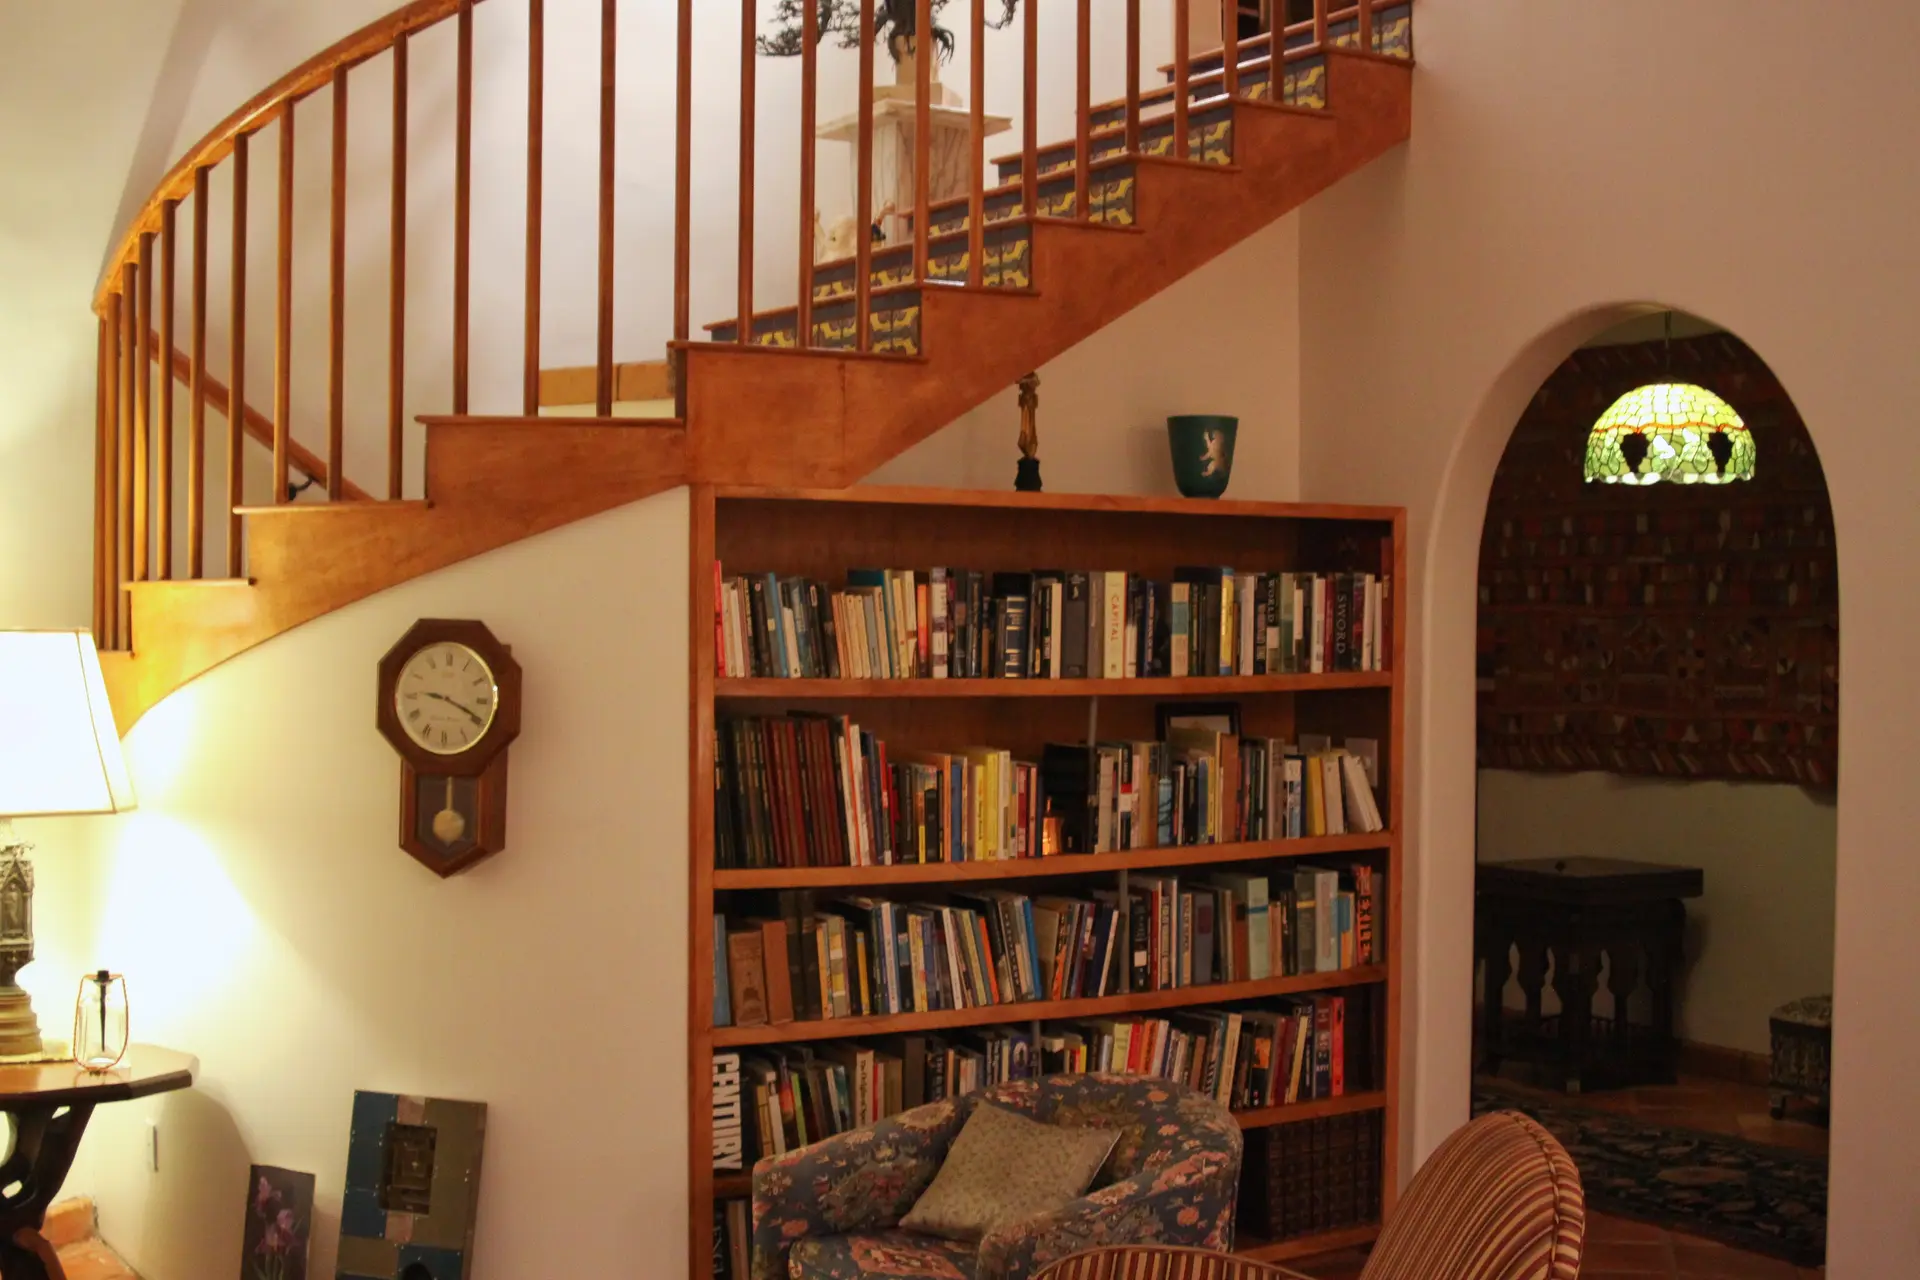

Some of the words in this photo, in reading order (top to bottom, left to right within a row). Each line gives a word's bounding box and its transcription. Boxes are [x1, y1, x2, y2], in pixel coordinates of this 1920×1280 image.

[1110, 593, 1120, 642] CAPITAL
[1267, 579, 1276, 622] WORLD
[1336, 594, 1347, 654] SWORD
[1359, 895, 1372, 948] EXILE
[713, 1053, 742, 1170] CENTURY
